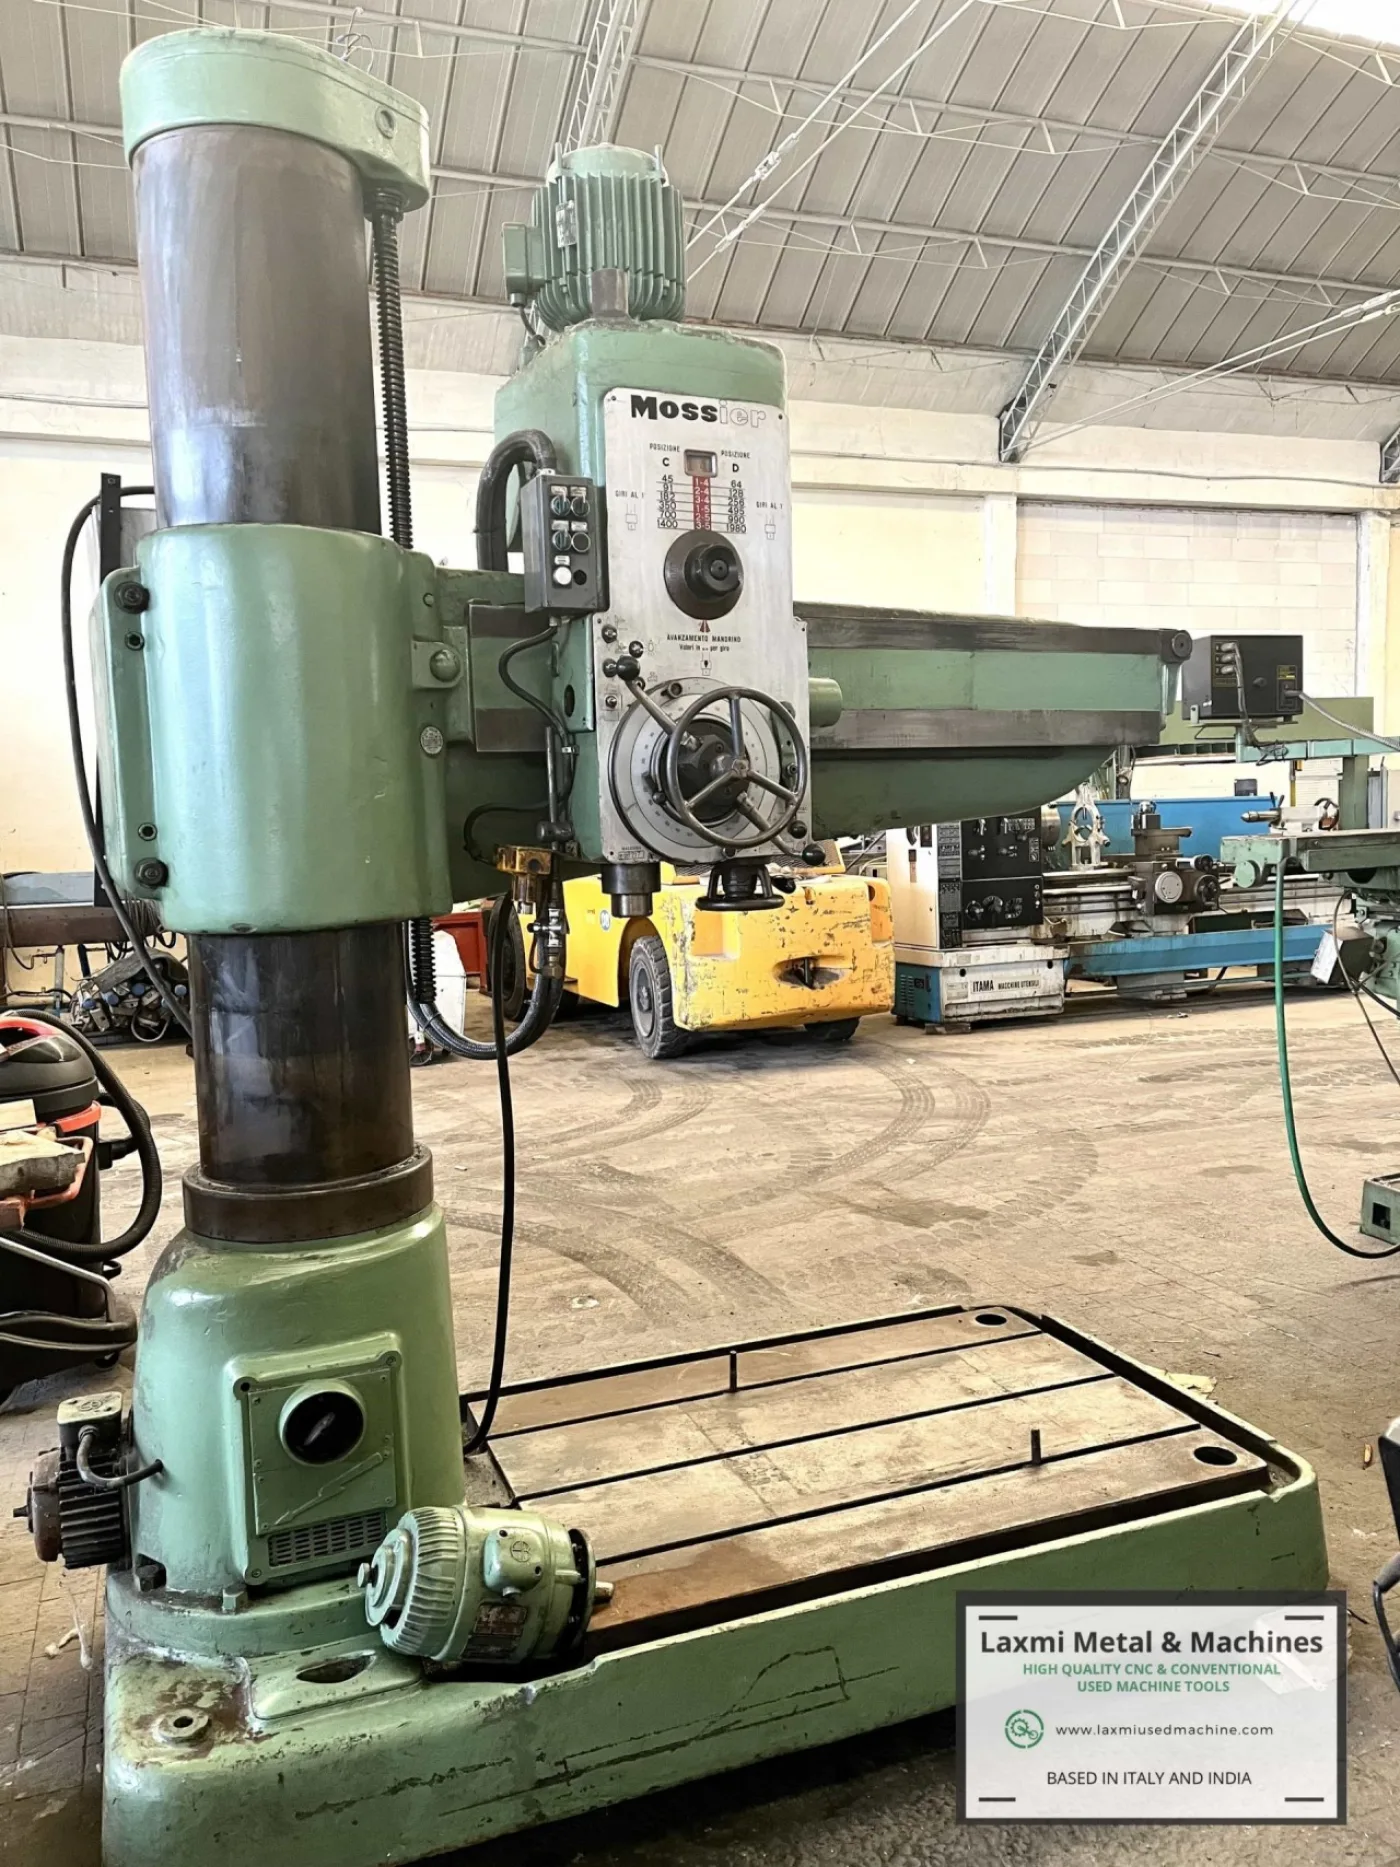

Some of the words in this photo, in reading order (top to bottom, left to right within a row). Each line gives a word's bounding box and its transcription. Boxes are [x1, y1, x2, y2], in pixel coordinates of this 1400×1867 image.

[649, 443, 680, 453] POSIZIONE
[721, 450, 750, 459] POSIZIONE
[662, 457, 670, 467] C
[732, 463, 739, 472] D
[662, 474, 674, 483] 45
[731, 480, 742, 488] 64
[667, 634, 709, 642] AVANZAMENTO
[711, 635, 742, 643] MANDRINO
[972, 980, 994, 992] ITAMA
